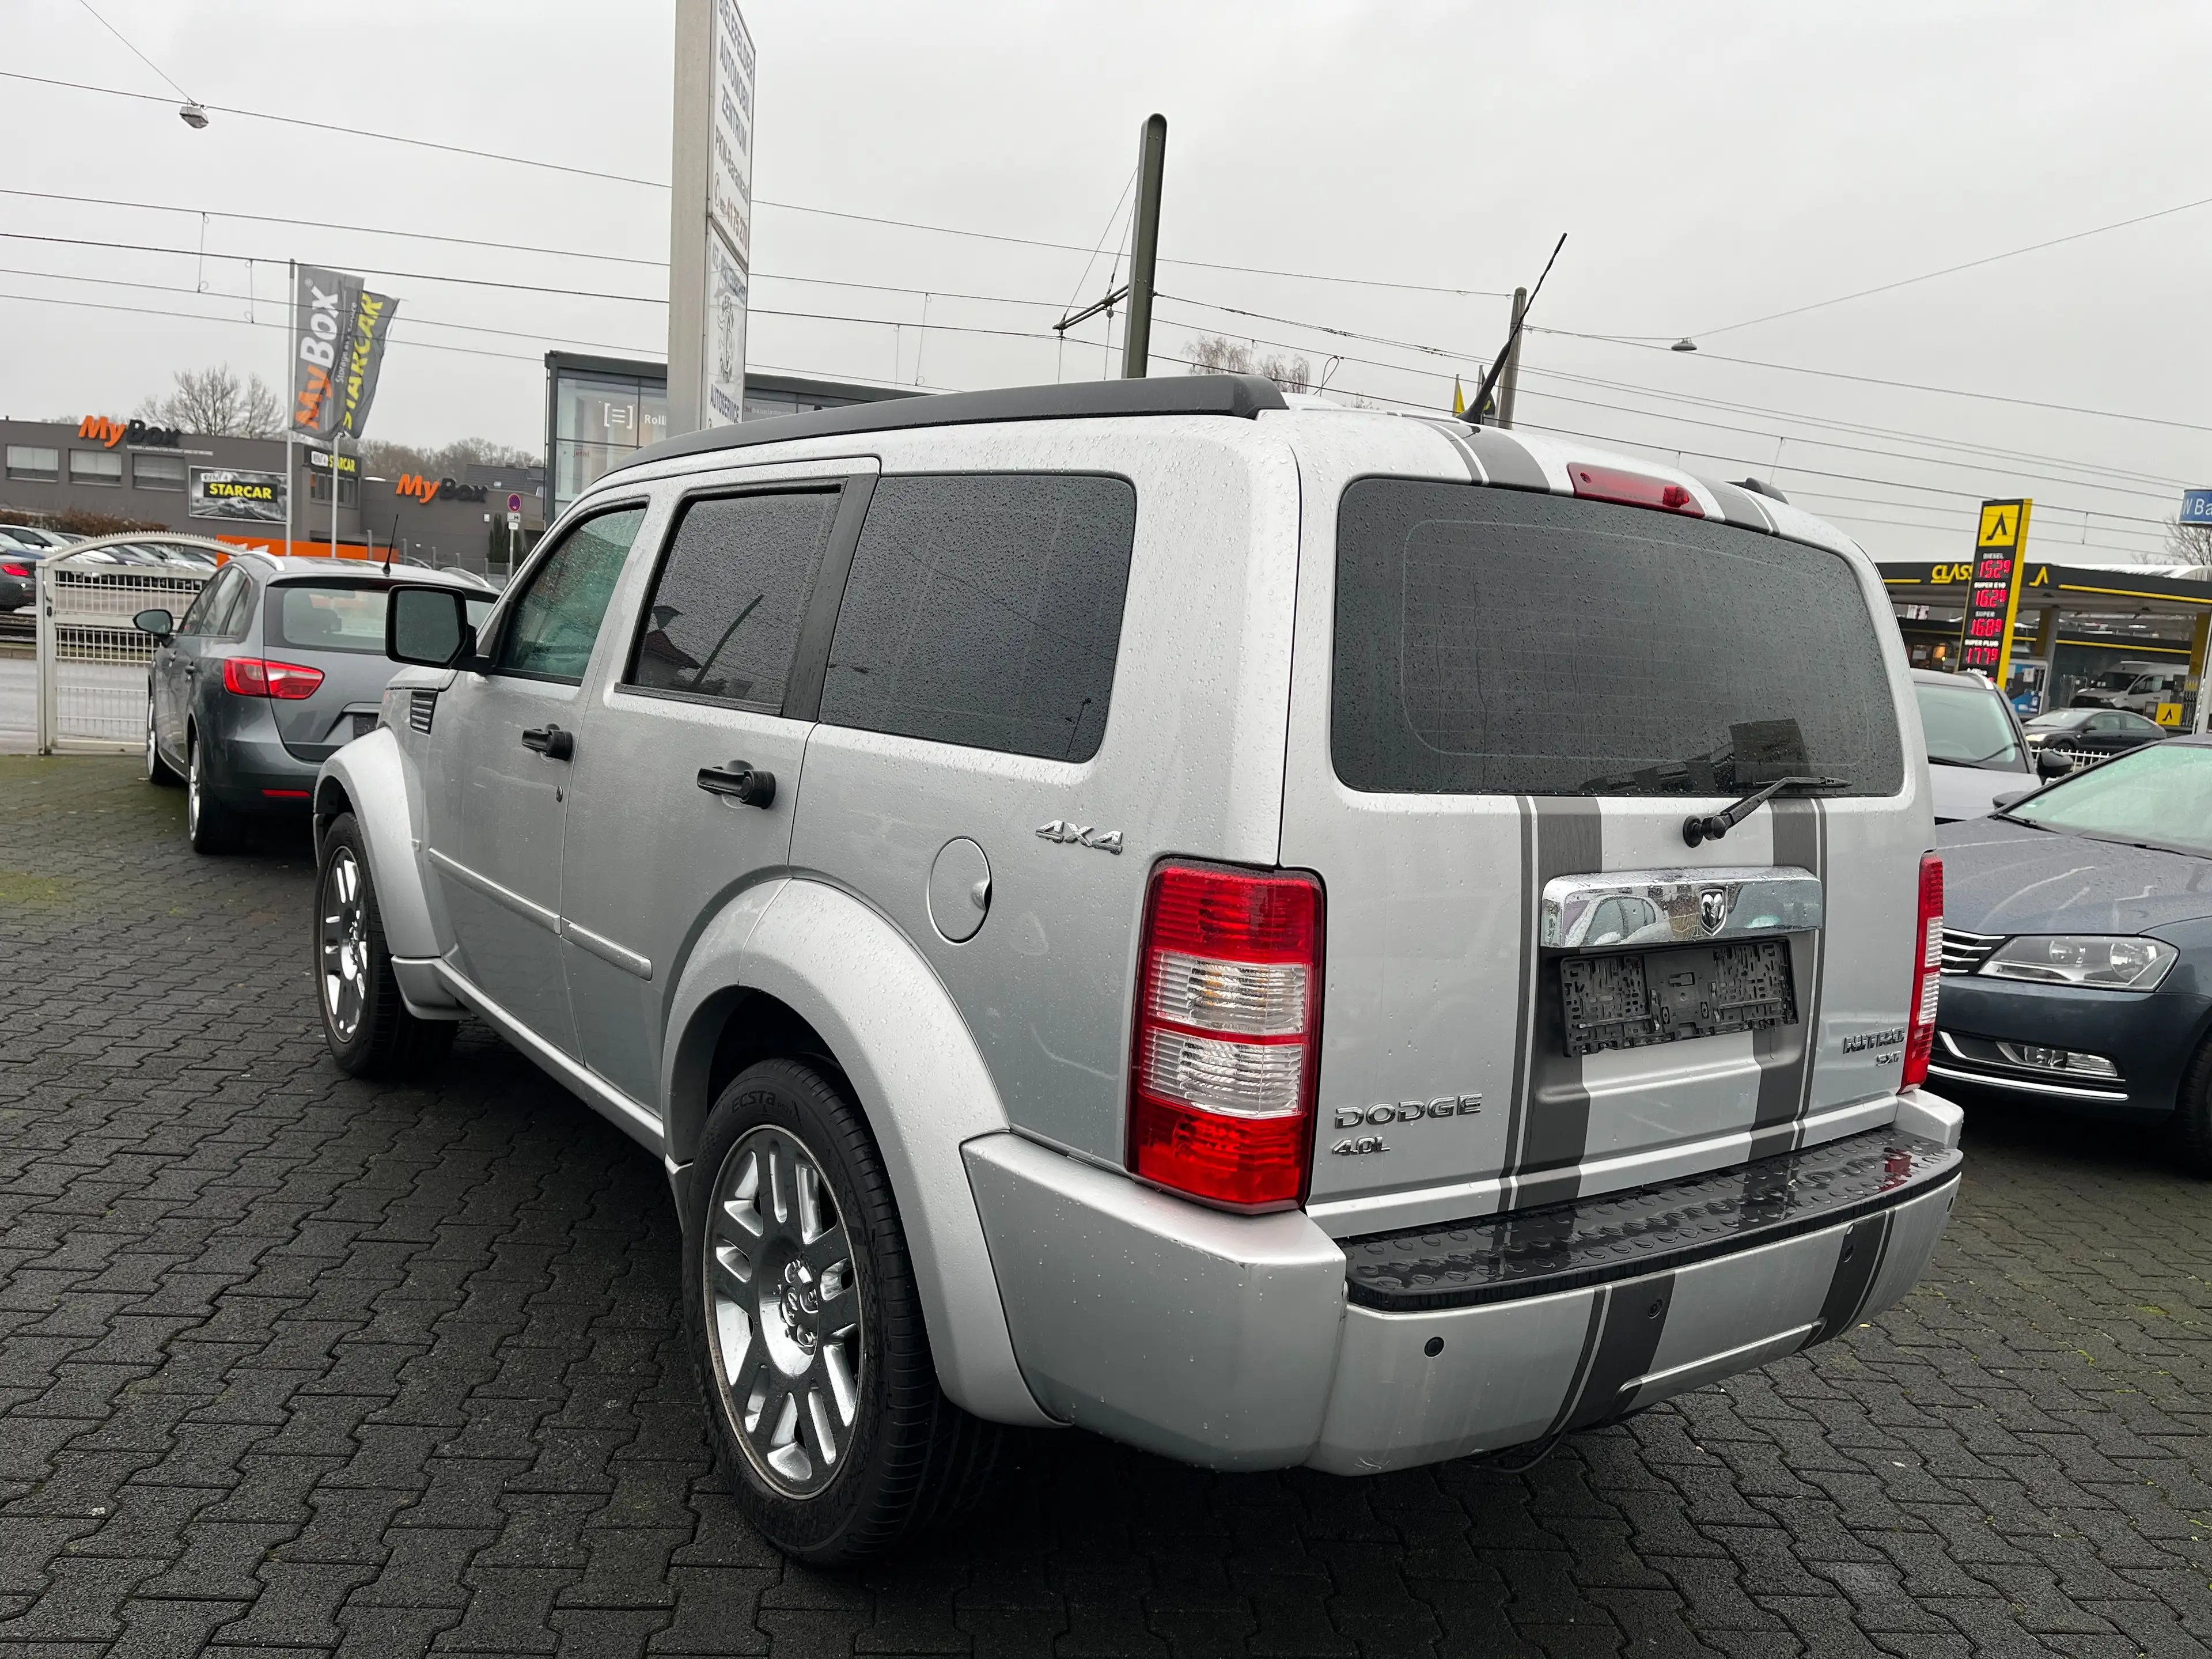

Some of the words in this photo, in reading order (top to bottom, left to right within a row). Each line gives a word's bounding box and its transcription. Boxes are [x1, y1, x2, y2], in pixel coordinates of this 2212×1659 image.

[719, 35, 750, 123] AUTOMOBIL
[722, 83, 747, 156] ZENTRUM
[710, 383, 739, 423] AUTOSERVICE
[78, 414, 181, 448] MyBox
[209, 483, 272, 500] STARCAR
[396, 474, 488, 505] MyBox
[1842, 1027, 1906, 1054] NITRO
[1874, 1050, 1902, 1067] SXT
[1335, 1093, 1483, 1129] DODGE
[1332, 1136, 1391, 1156] 4.0L
